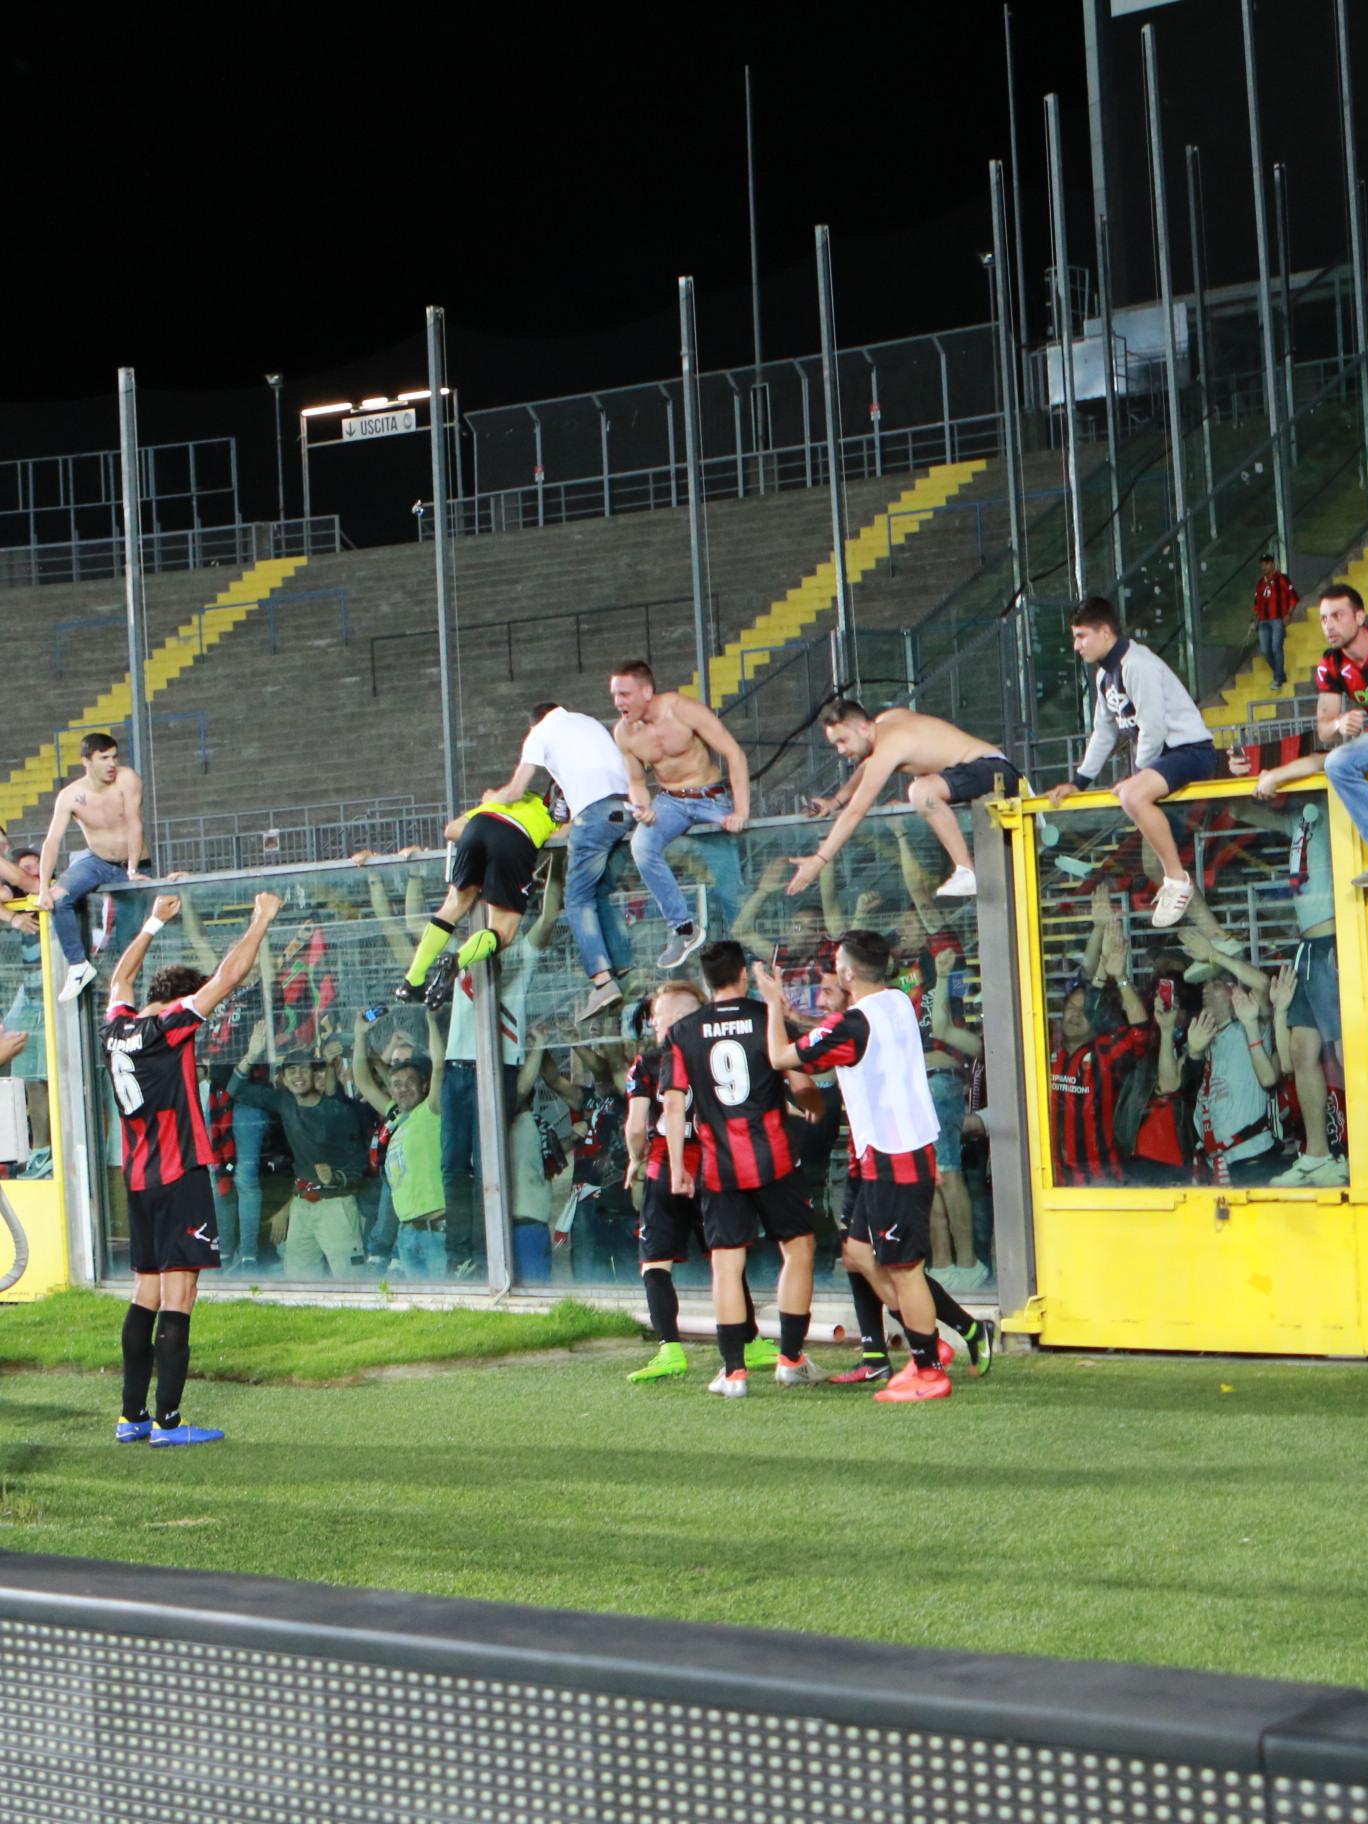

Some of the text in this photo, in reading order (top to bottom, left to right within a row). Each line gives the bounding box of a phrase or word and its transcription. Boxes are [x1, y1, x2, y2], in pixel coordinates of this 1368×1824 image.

[360, 416, 398, 435] USCITA
[703, 1019, 753, 1039] RAFFINI
[111, 1051, 144, 1116] 6
[710, 1039, 750, 1106] 9
